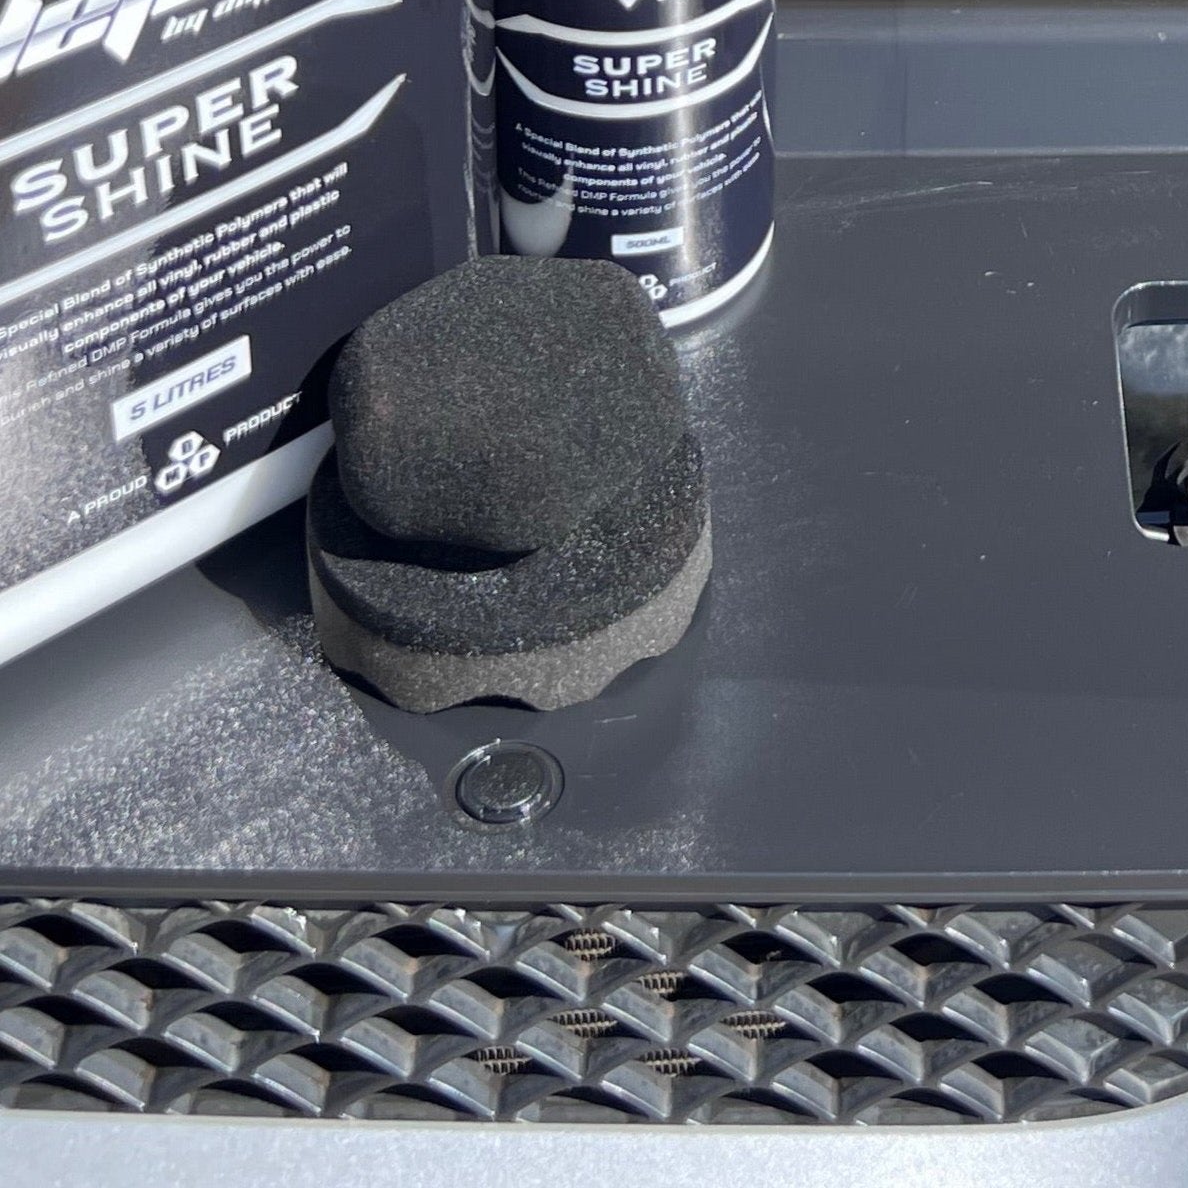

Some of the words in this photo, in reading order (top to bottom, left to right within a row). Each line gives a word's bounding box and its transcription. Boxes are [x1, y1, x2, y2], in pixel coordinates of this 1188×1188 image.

[572, 37, 717, 76] SUPER
[584, 63, 708, 99] SHINE
[10, 55, 299, 215] SUPER
[40, 103, 282, 244] SHINE
[601, 148, 617, 157] of
[640, 174, 655, 186] of
[62, 279, 112, 310] Blend
[115, 269, 133, 286] of
[135, 232, 215, 277] Synthetic
[215, 196, 288, 240] Polymers
[289, 177, 322, 202] that
[323, 161, 348, 185] will
[63, 293, 134, 332] enhance
[137, 279, 157, 299] all
[203, 232, 257, 268] rubber
[258, 214, 288, 239] and
[289, 190, 340, 227] plastic
[91, 337, 127, 363] DMP
[129, 308, 191, 346] Formula
[192, 287, 233, 317] gives
[233, 272, 263, 294] you
[264, 258, 290, 278] the
[290, 234, 334, 266] power
[335, 224, 351, 239] to
[55, 379, 85, 401] and
[88, 359, 131, 387] shine
[133, 352, 144, 364] a
[145, 324, 199, 357] variety
[200, 312, 218, 331] of
[220, 281, 283, 321] surfaces
[283, 265, 315, 289] with
[64, 299, 166, 353] components
[167, 286, 186, 307] of
[187, 270, 225, 298] your
[129, 400, 148, 422] 5
[152, 356, 237, 411] LITRES
[66, 509, 81, 525] A
[83, 474, 148, 515] PROUD
[223, 390, 303, 446] PRODUCT
